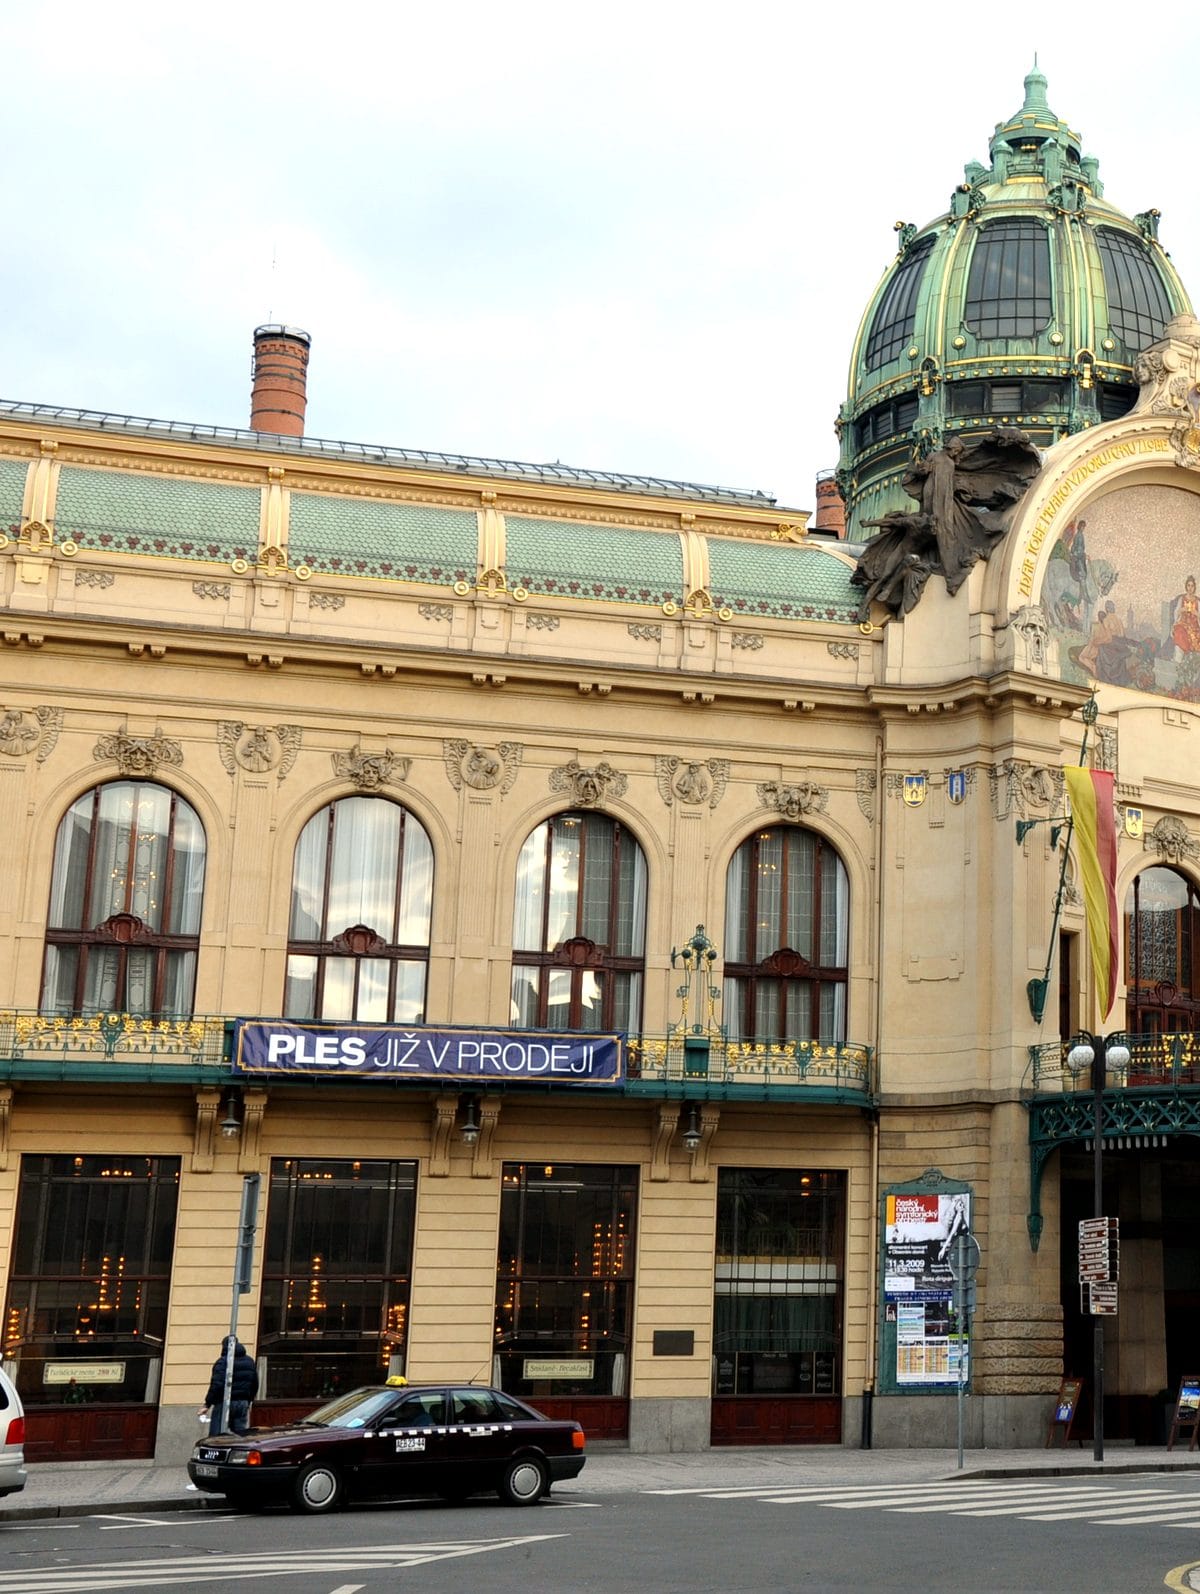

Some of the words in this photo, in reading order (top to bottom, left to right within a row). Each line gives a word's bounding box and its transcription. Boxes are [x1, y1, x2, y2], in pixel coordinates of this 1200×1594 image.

[268, 1033, 366, 1066] PLES
[374, 1033, 421, 1068] JIŽ
[427, 1040, 451, 1069] V
[458, 1041, 593, 1074] PRODEJI
[889, 1260, 925, 1268] 11.3.2009
